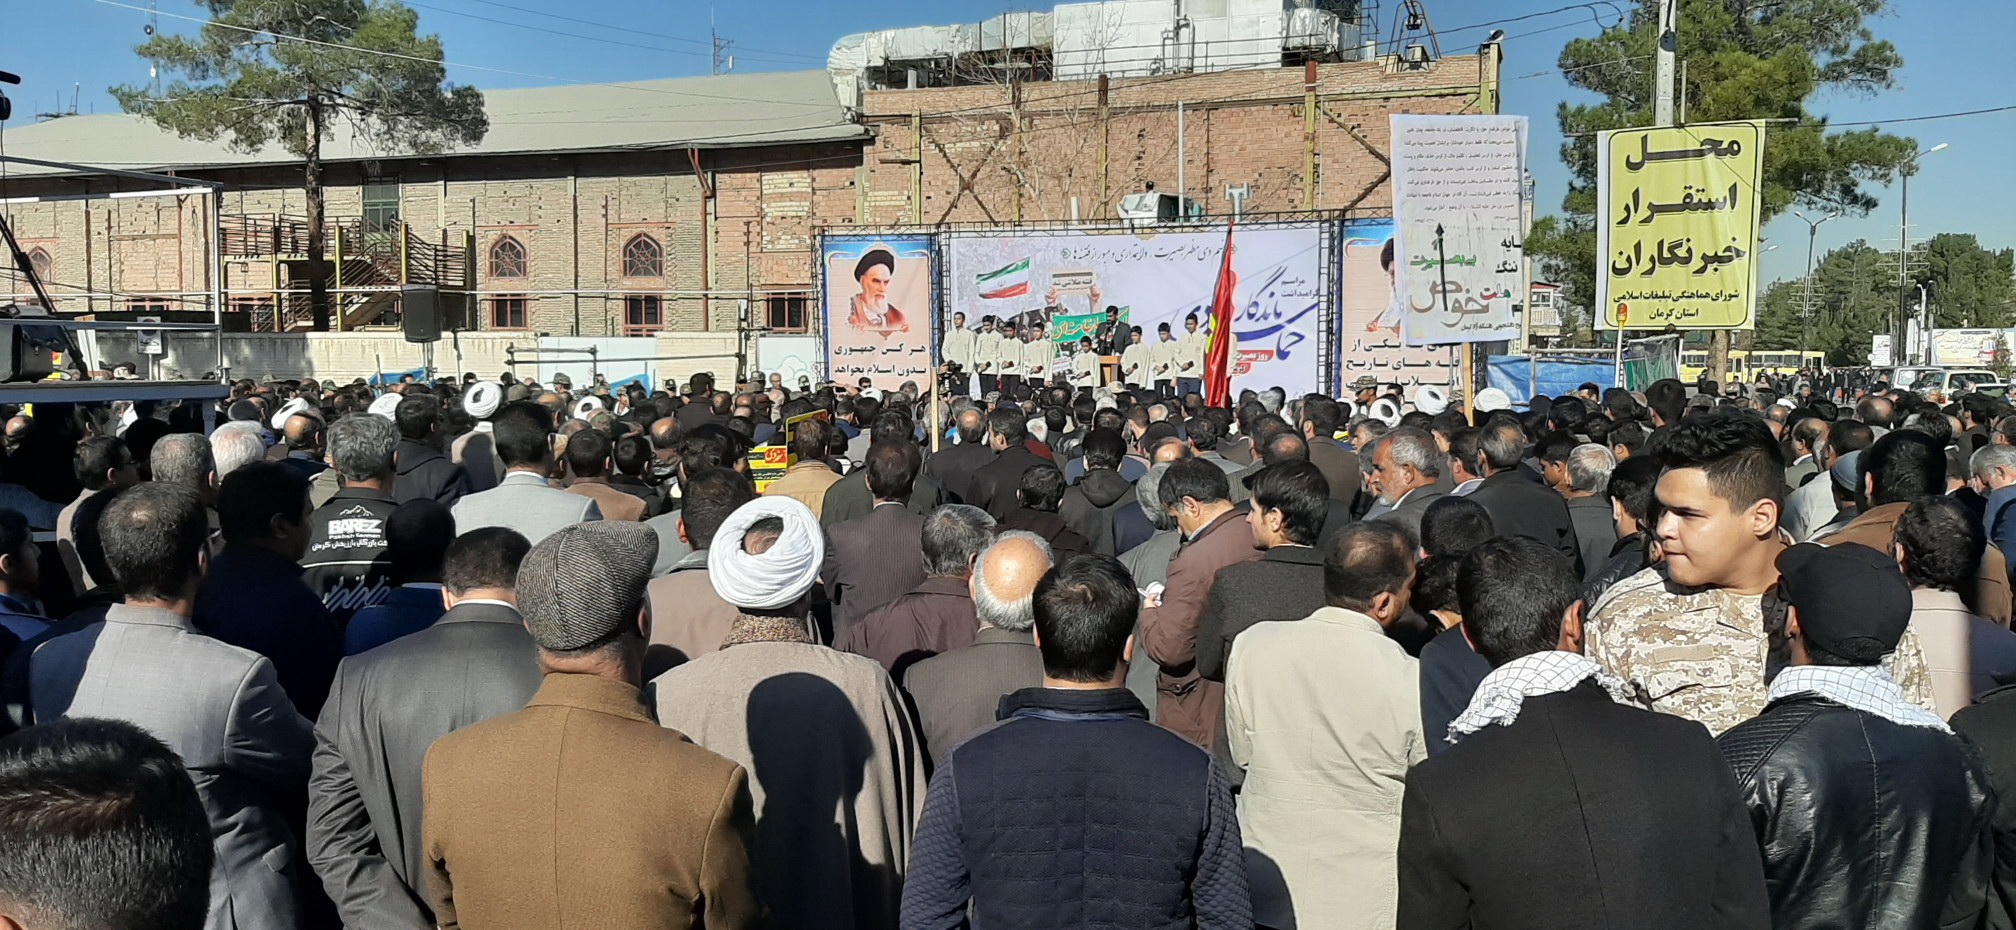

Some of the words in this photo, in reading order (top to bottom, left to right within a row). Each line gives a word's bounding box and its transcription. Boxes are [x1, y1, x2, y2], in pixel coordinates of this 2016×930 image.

[1626, 133, 1741, 172] محل
[1616, 182, 1738, 226] استقرار
[1611, 236, 1747, 276] خبرنگاران
[1281, 276, 1306, 287] مراسم
[1613, 291, 1642, 303] اسلامی
[1643, 290, 1672, 302] تبلیغات
[1672, 289, 1710, 302] هماهنگی
[1710, 289, 1740, 301] شورای
[1649, 308, 1675, 320] کرمان
[1675, 308, 1699, 319] استان
[834, 345, 876, 355] جمهوری
[881, 343, 904, 355] کس
[909, 345, 926, 355] هر
[1351, 338, 1361, 352] از
[1364, 338, 1401, 352] یکی
[1346, 357, 1388, 371] تاریخ
[1392, 357, 1431, 370] های
[1435, 356, 1460, 367] قه
[867, 364, 895, 376] اسلام
[897, 367, 927, 376] بدون
[328, 518, 382, 534] BAREZ
